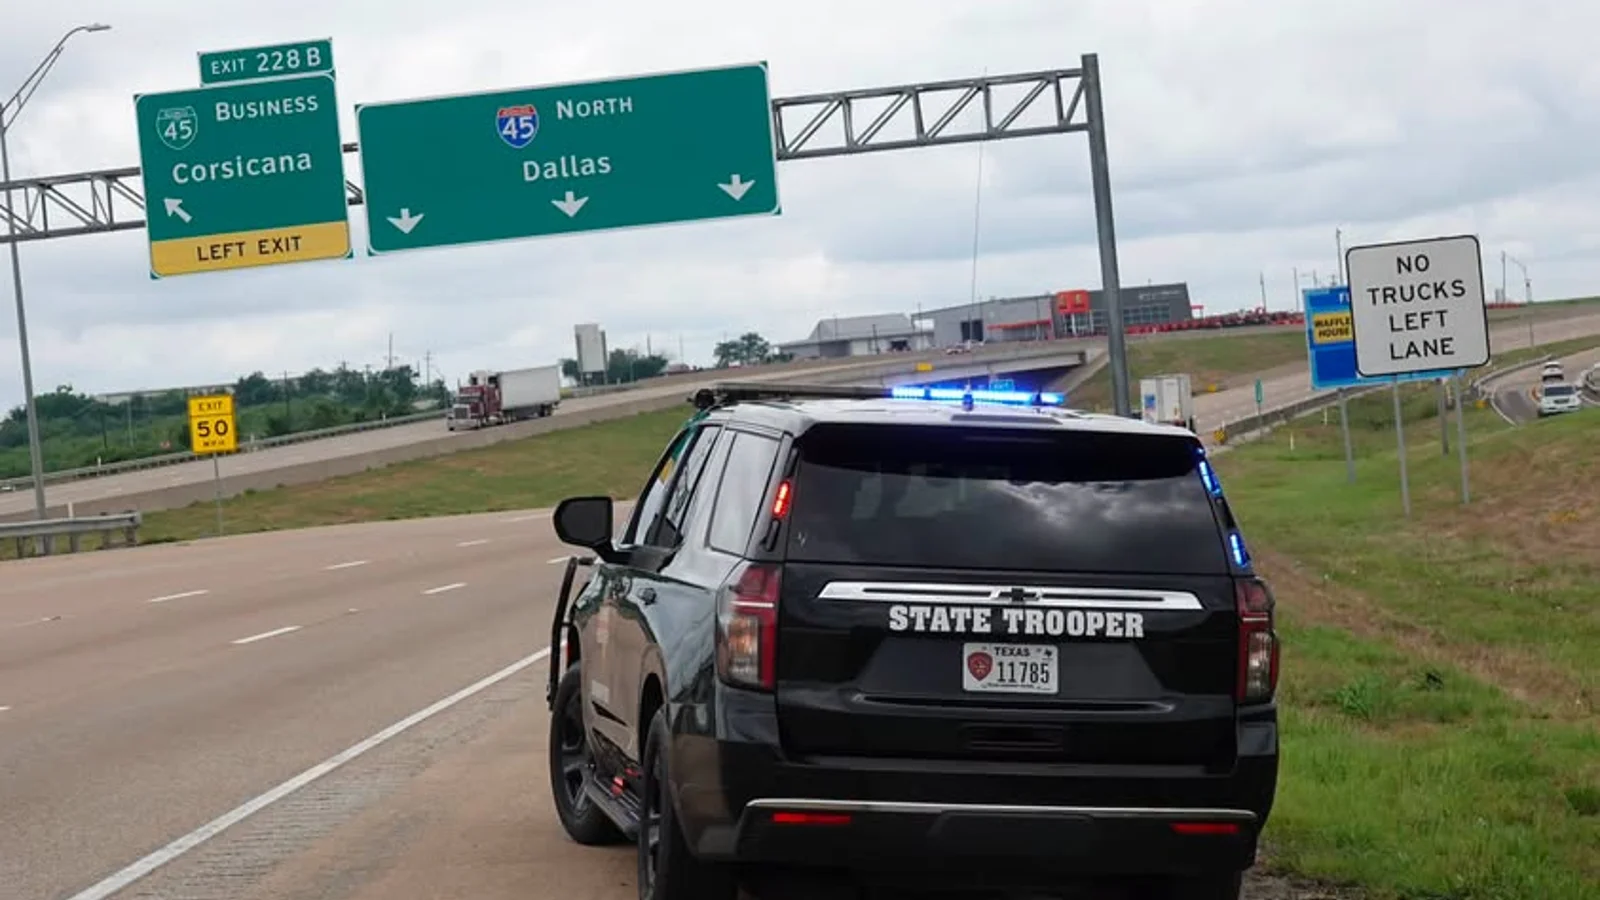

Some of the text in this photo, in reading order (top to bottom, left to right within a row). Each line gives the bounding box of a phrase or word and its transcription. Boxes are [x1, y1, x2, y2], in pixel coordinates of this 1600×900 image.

[210, 47, 322, 75] EXIT 228 B
[215, 95, 319, 121] BUSINESS
[556, 96, 633, 120] NORTH
[164, 119, 193, 140] 45
[502, 115, 534, 139] 45
[172, 152, 312, 184] Corsicana
[523, 154, 612, 182] Dallas
[197, 235, 303, 261] LEFT EXIT
[1396, 254, 1431, 274] NO
[1366, 279, 1466, 306] TRUCKS
[1315, 316, 1350, 327] WAFFLE
[1318, 327, 1349, 338] HOUSE
[1389, 310, 1449, 332] LEFT
[1390, 337, 1455, 360] LANE
[198, 400, 222, 411] EXIT
[197, 419, 229, 438] 50
[889, 605, 1144, 638] STATE TROOPER
[994, 646, 1031, 657] TEXAS
[997, 660, 1050, 684] 11785
